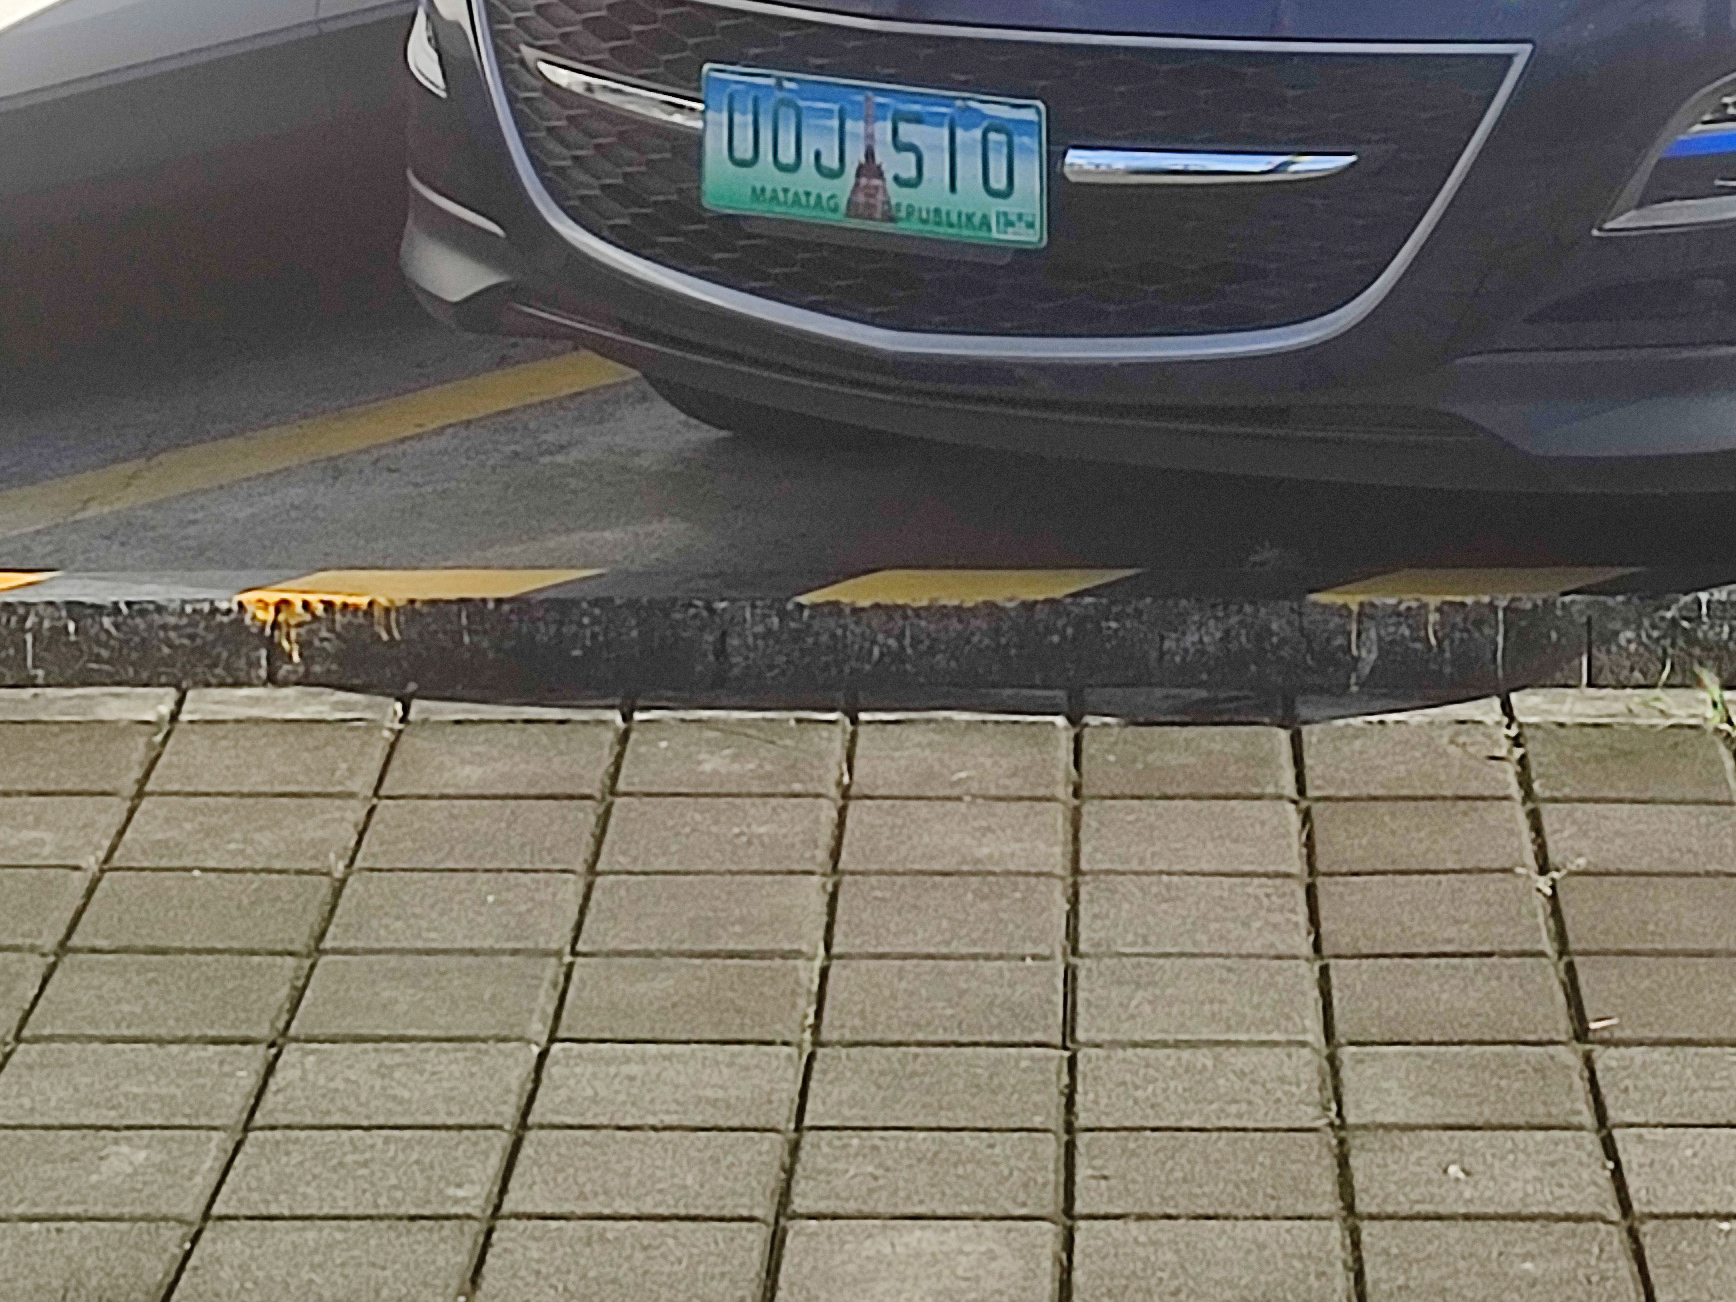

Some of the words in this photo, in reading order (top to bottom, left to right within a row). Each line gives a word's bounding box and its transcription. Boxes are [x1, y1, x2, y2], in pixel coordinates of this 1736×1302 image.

[726, 87, 846, 181] UOJ
[891, 105, 1015, 200] 510
[750, 184, 840, 214] MATATAG
